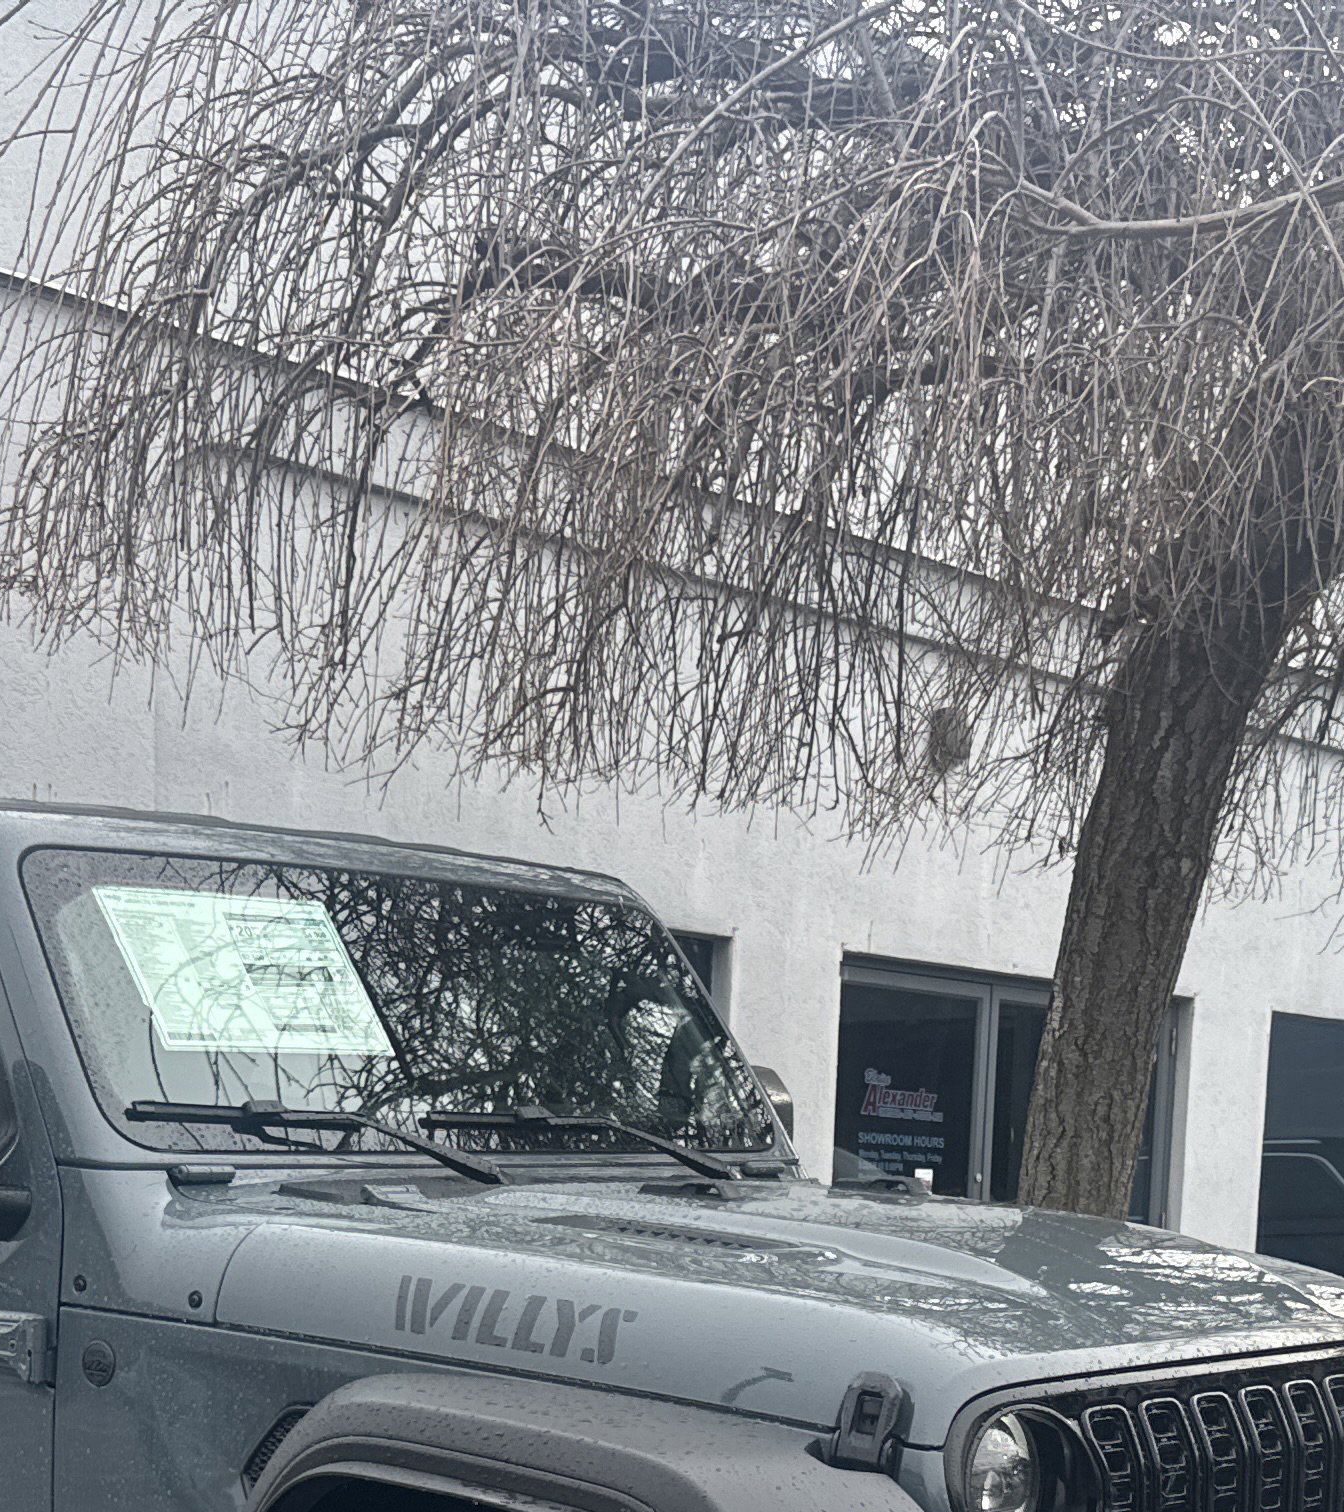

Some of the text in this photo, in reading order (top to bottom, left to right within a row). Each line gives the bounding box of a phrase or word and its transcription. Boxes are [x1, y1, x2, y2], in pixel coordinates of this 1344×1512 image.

[861, 1083, 938, 1116] Alexander
[858, 1131, 945, 1149] SHOWROOM HOURS
[394, 1274, 639, 1365] WILLYS
